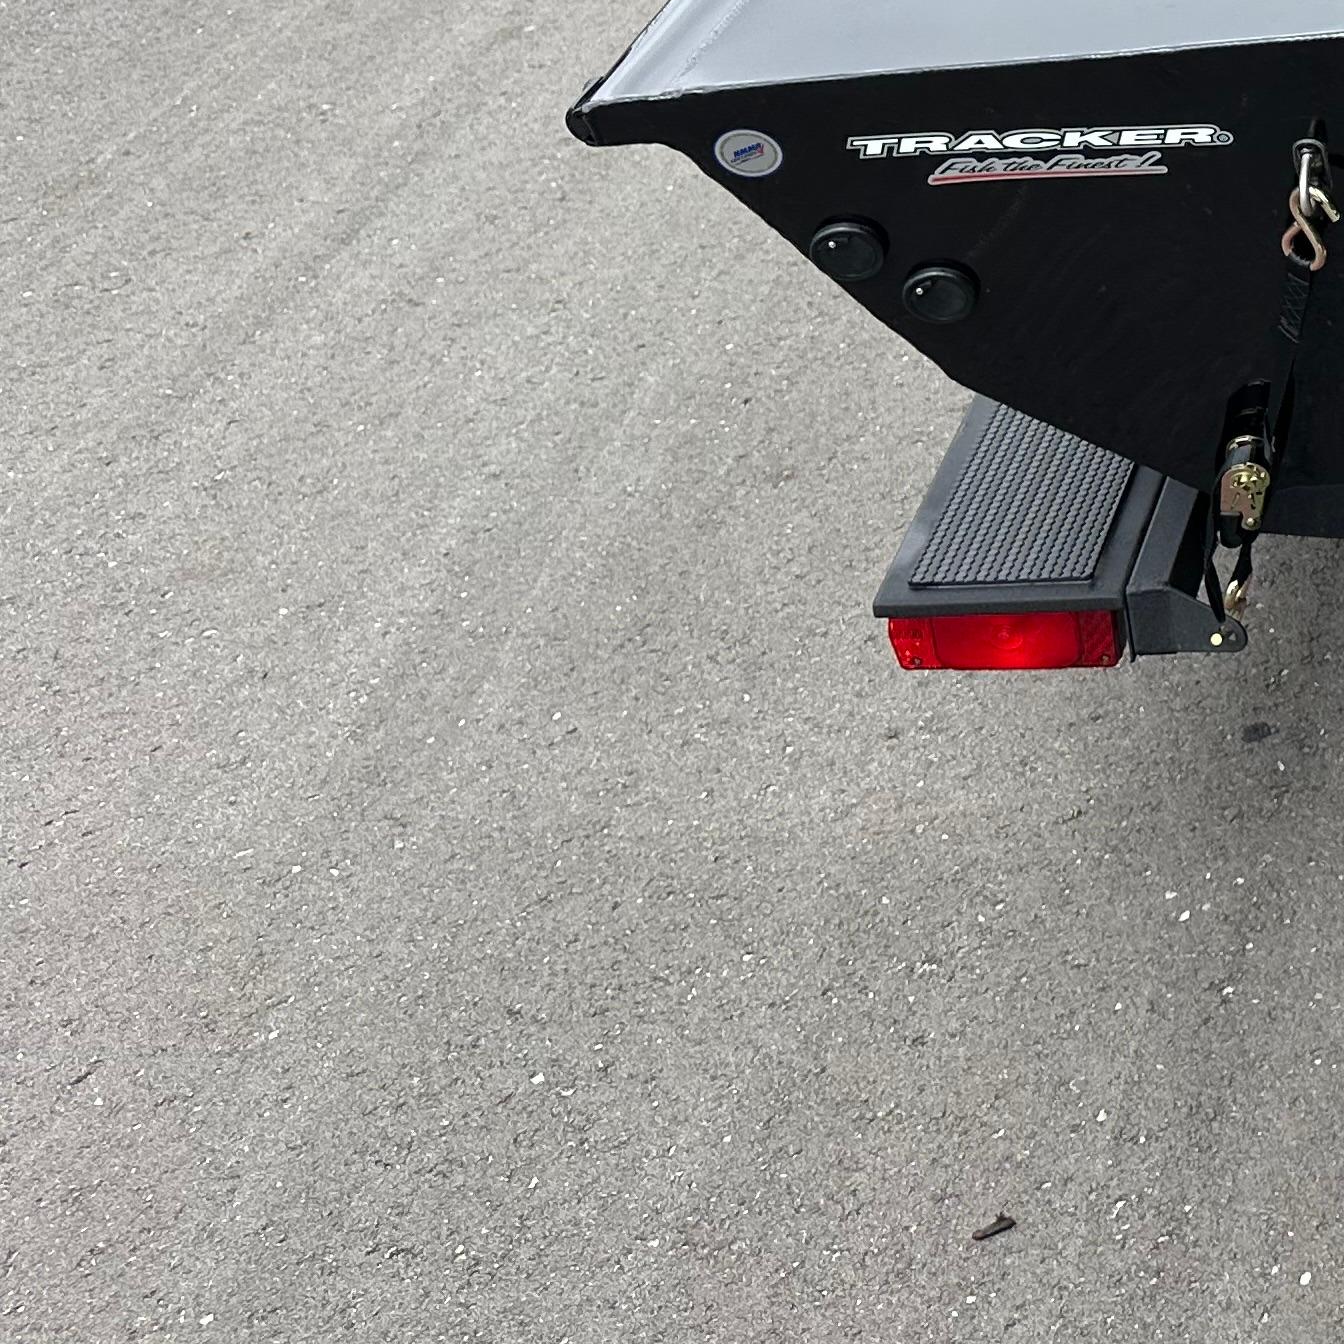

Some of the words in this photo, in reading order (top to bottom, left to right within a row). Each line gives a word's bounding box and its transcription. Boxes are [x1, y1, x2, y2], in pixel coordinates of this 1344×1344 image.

[939, 160, 995, 175] Fish
[1002, 158, 1043, 173] the
[1049, 155, 1130, 172] Finest
